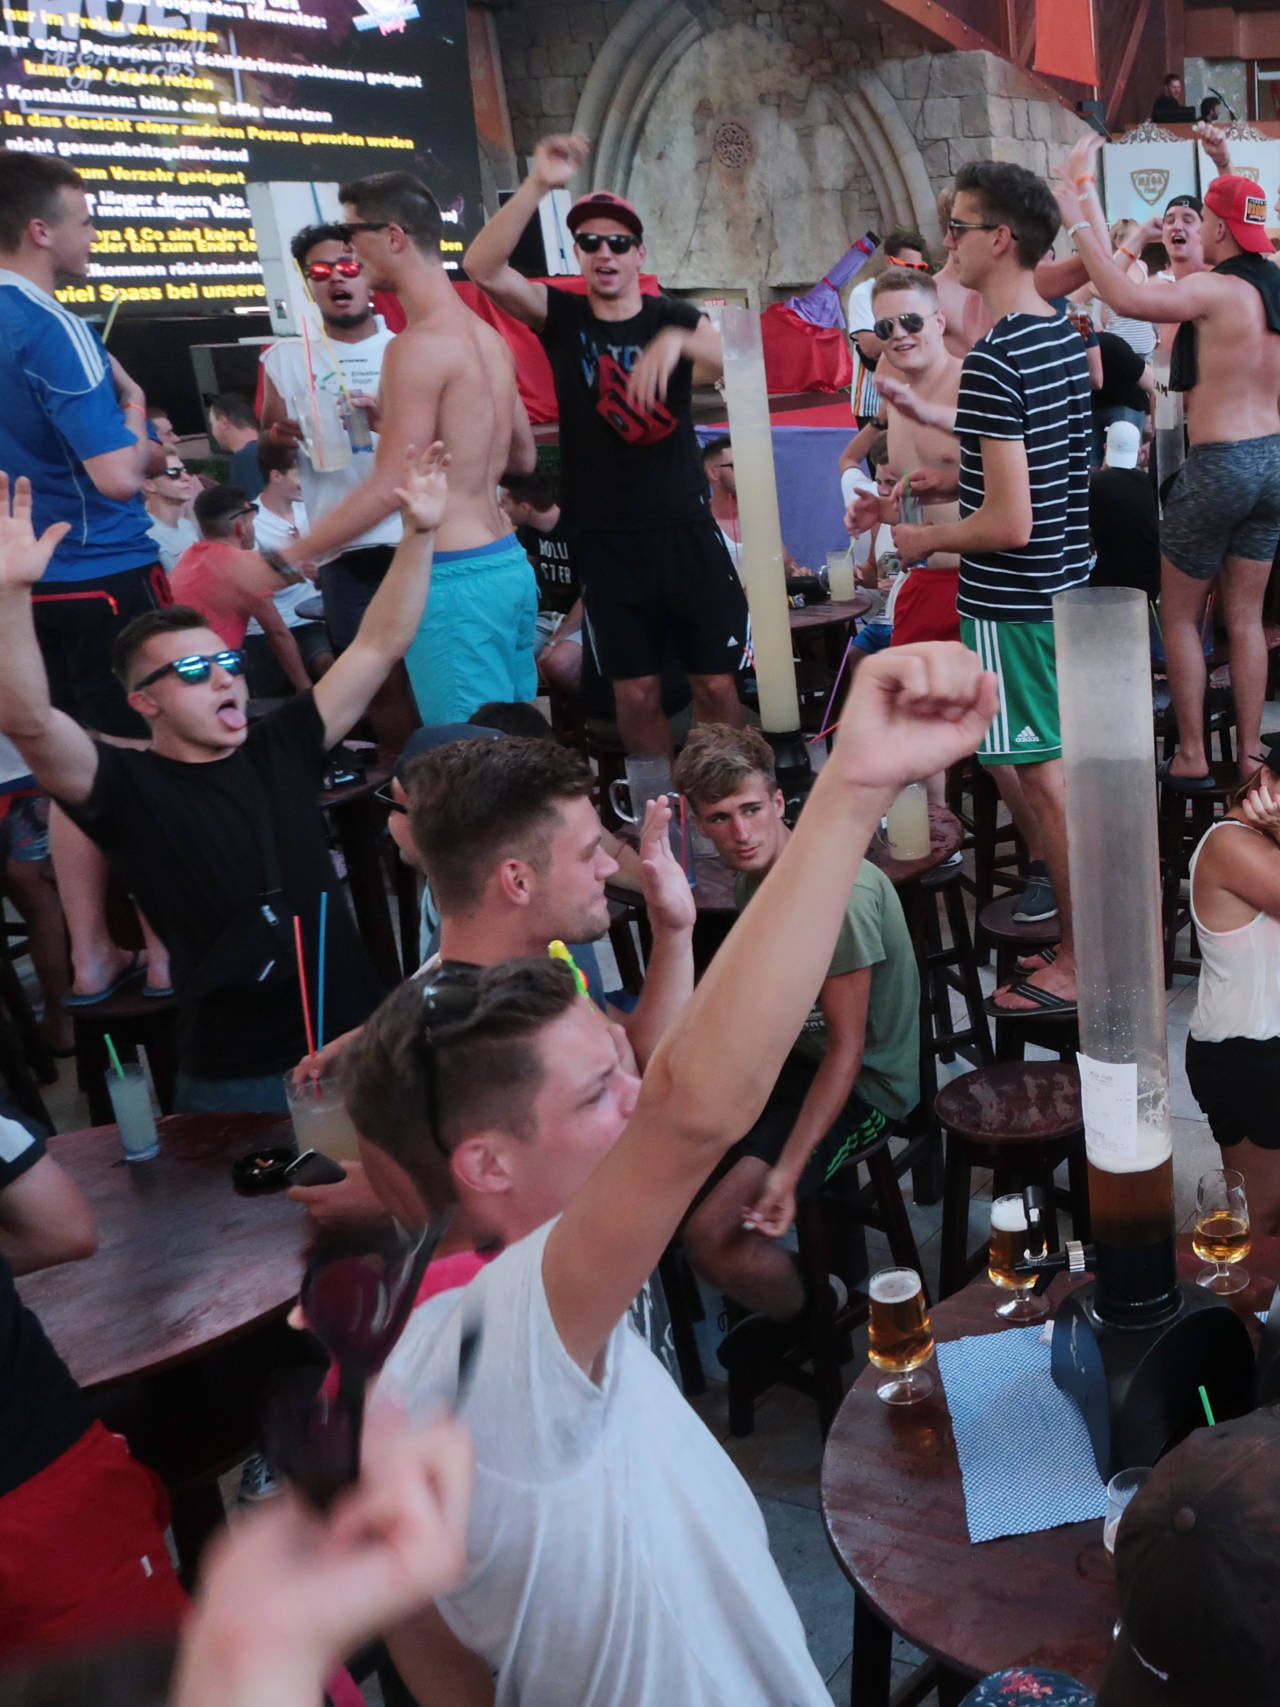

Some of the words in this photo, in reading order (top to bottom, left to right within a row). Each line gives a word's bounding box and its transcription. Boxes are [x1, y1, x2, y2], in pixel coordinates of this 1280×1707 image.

[3, 8, 36, 23] nur
[40, 9, 64, 26] im
[67, 12, 126, 33] Freien
[127, 22, 219, 43] verwenden
[246, 2, 328, 29] Hinweise:
[34, 35, 78, 53] oder
[80, 39, 162, 62] Personen
[164, 50, 194, 65] mit
[365, 71, 422, 88] geeignet
[23, 58, 71, 78] kann
[73, 64, 103, 80] die
[105, 66, 161, 87] Augen
[162, 73, 214, 90] reizen
[139, 94, 180, 111] bitte
[181, 98, 218, 115] eine
[218, 100, 260, 117] Brille
[262, 105, 333, 123] aufsetzen
[3, 109, 24, 126] in
[27, 112, 62, 128] das
[64, 114, 133, 132] Gesicht
[134, 119, 180, 135] einer
[181, 123, 245, 139] anderen
[246, 125, 299, 143] Person
[301, 132, 365, 146] geworfen
[365, 136, 415, 149] werden
[5, 136, 56, 154] nicht
[109, 165, 176, 182] Verzehr
[176, 169, 247, 186] geeignet
[98, 190, 155, 209] länger
[218, 193, 246, 208] bis
[96, 204, 210, 221] mehrmaligem
[123, 226, 139, 241] &
[140, 226, 165, 241] Co
[166, 227, 202, 241] sind
[203, 227, 247, 241] keine
[129, 239, 156, 253] bis
[158, 241, 195, 253] zum
[196, 239, 237, 253] Ende
[54, 283, 96, 303] viel
[98, 283, 163, 304] Spass
[165, 282, 199, 300] bei
[201, 283, 267, 298] unsere
